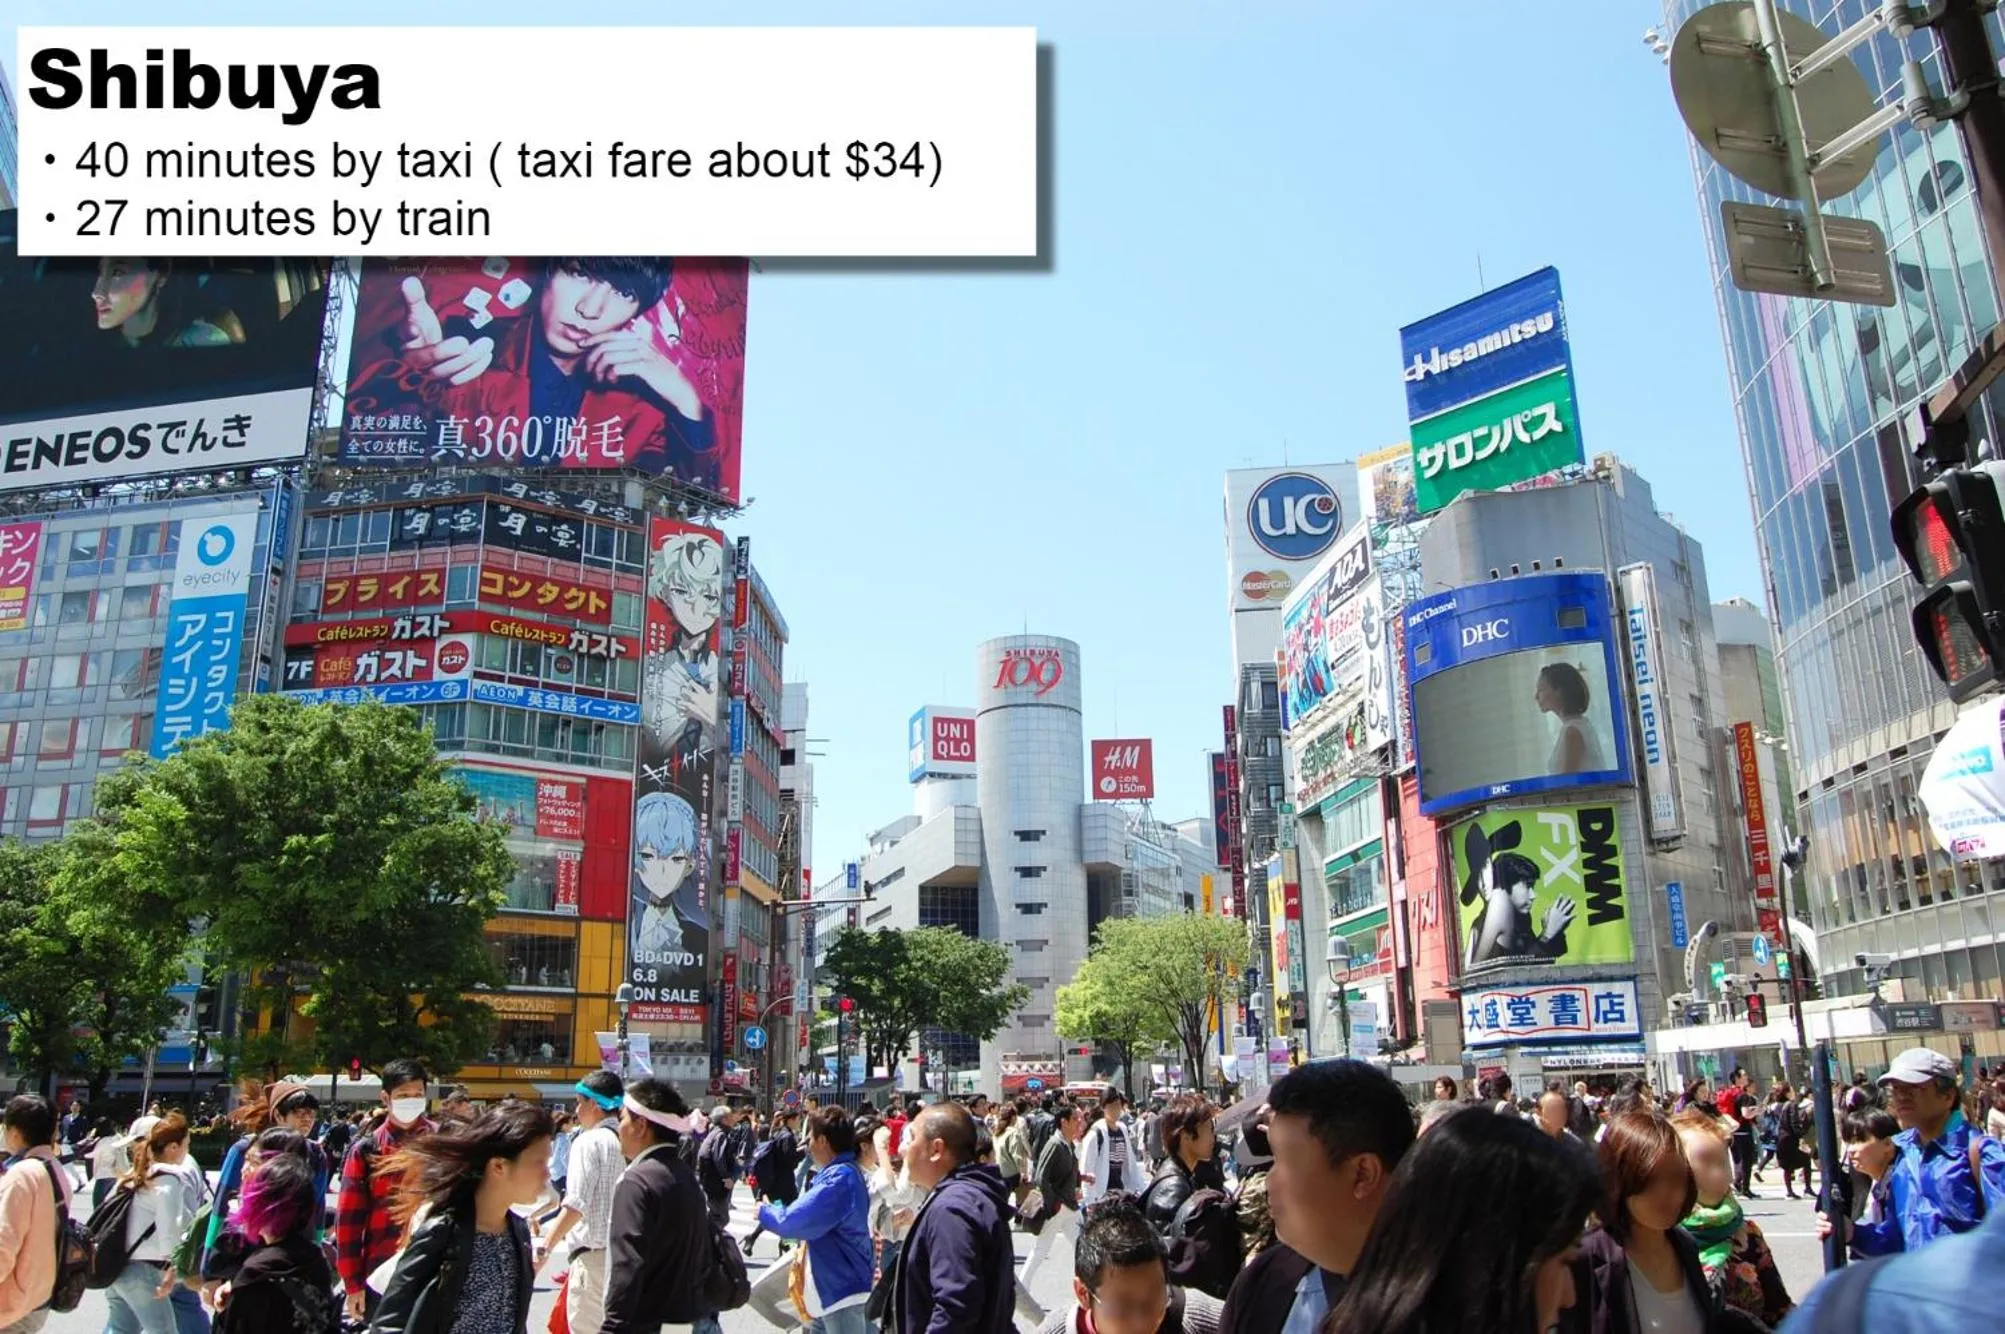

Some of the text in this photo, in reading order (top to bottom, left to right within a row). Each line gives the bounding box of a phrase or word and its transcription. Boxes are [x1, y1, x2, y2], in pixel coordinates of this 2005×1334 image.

[1417, 402, 1562, 479] サロンパス
[183, 570, 240, 586] eyecity
[326, 573, 441, 604] プライス
[481, 572, 607, 614] コンタクト
[391, 615, 450, 639] ガスト
[1461, 618, 1510, 648] DHC
[568, 630, 627, 658] ガスト
[1005, 649, 1060, 658] SHIBUYA
[286, 661, 314, 679] 7F
[353, 650, 427, 682] ガスト
[442, 655, 465, 666] ガスト
[992, 657, 1064, 697] 109
[480, 683, 516, 699] AEON
[528, 691, 638, 717] 英会話イーオン
[937, 722, 968, 738] UNI
[1640, 692, 1660, 765] neon
[937, 740, 971, 758] QLO
[1119, 783, 1147, 792] 150m
[1491, 784, 1511, 795] DHC
[1537, 812, 1584, 888] FX
[1577, 807, 1625, 927] DMM
[632, 968, 657, 982] 6.8
[633, 988, 700, 1003] ON SALE
[1467, 991, 1626, 1032] 大盛堂書店
